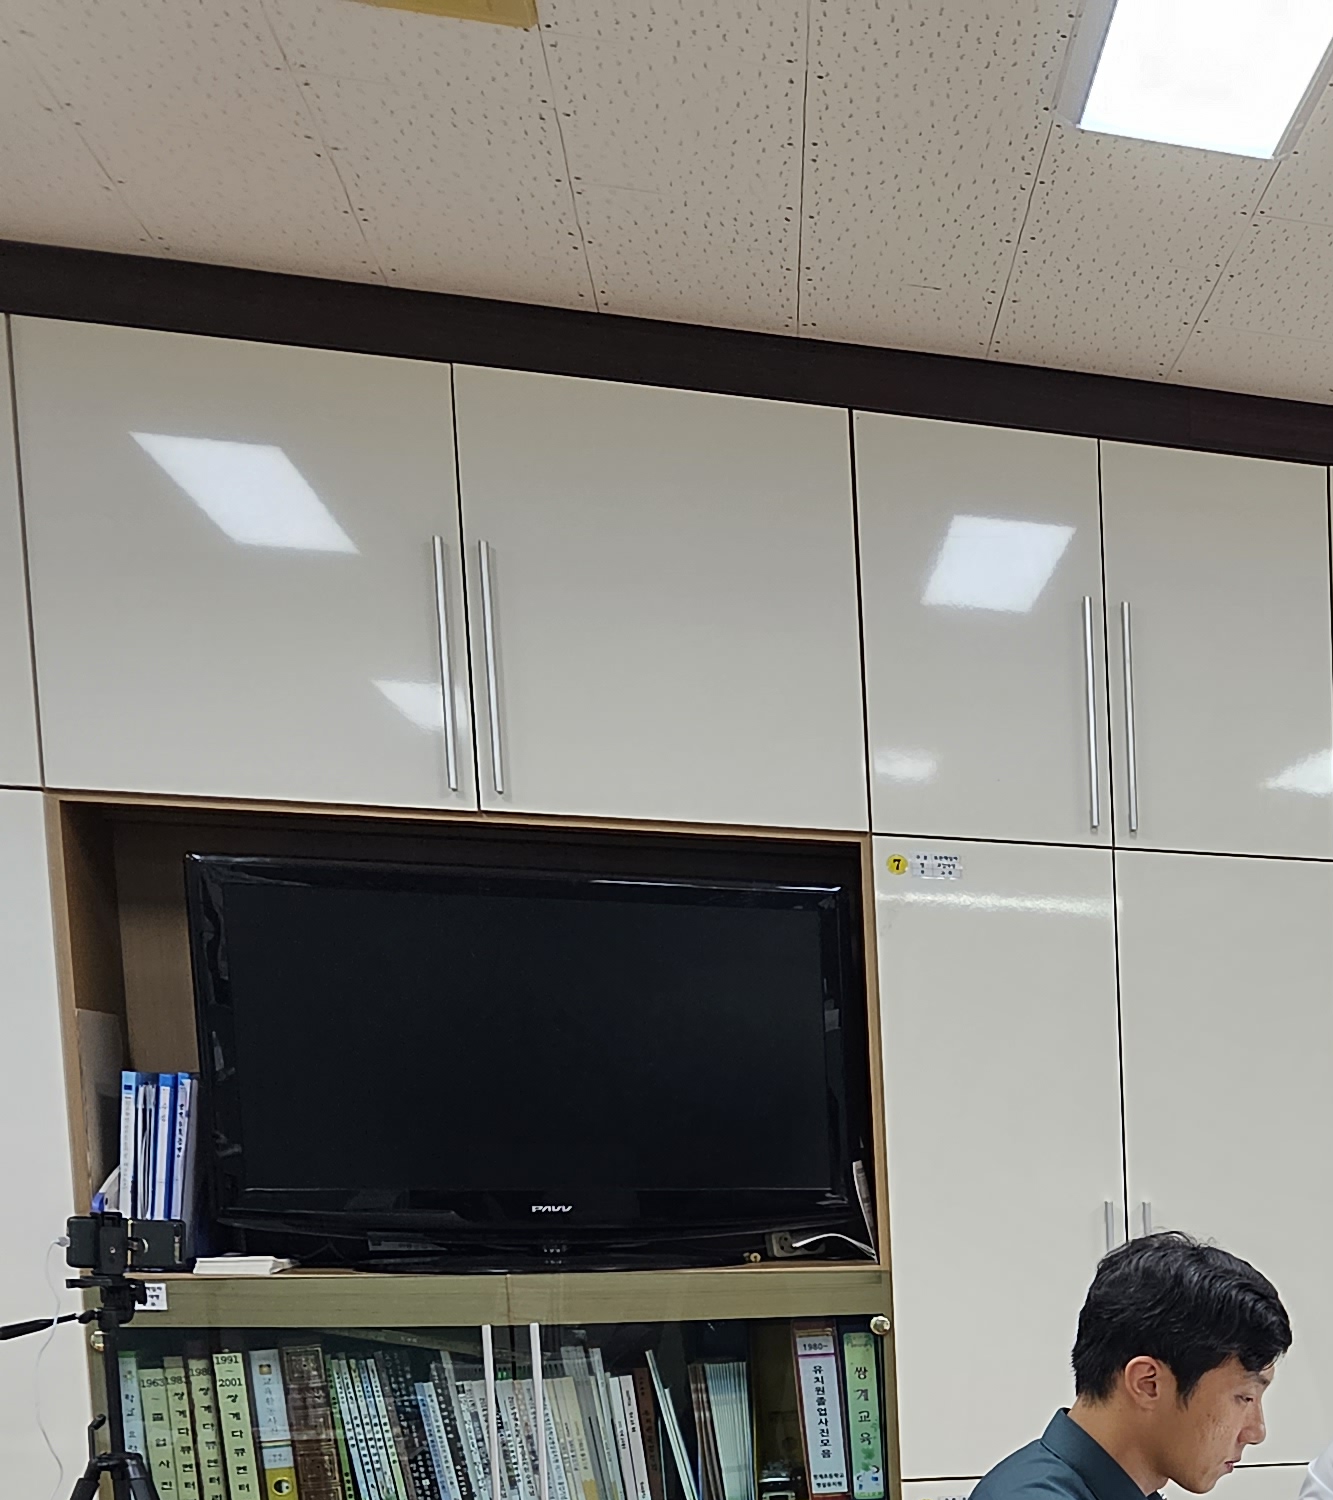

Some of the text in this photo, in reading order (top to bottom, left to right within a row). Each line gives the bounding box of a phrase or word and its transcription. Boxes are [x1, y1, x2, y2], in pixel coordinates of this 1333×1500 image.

[893, 858, 902, 870] 7
[531, 1205, 573, 1214] PAVV
[214, 1355, 240, 1365] 1991
[218, 1378, 243, 1387] 2001
[811, 1364, 833, 1459] 유치원졸업사진모음
[853, 1366, 874, 1446] 쌍계교육
